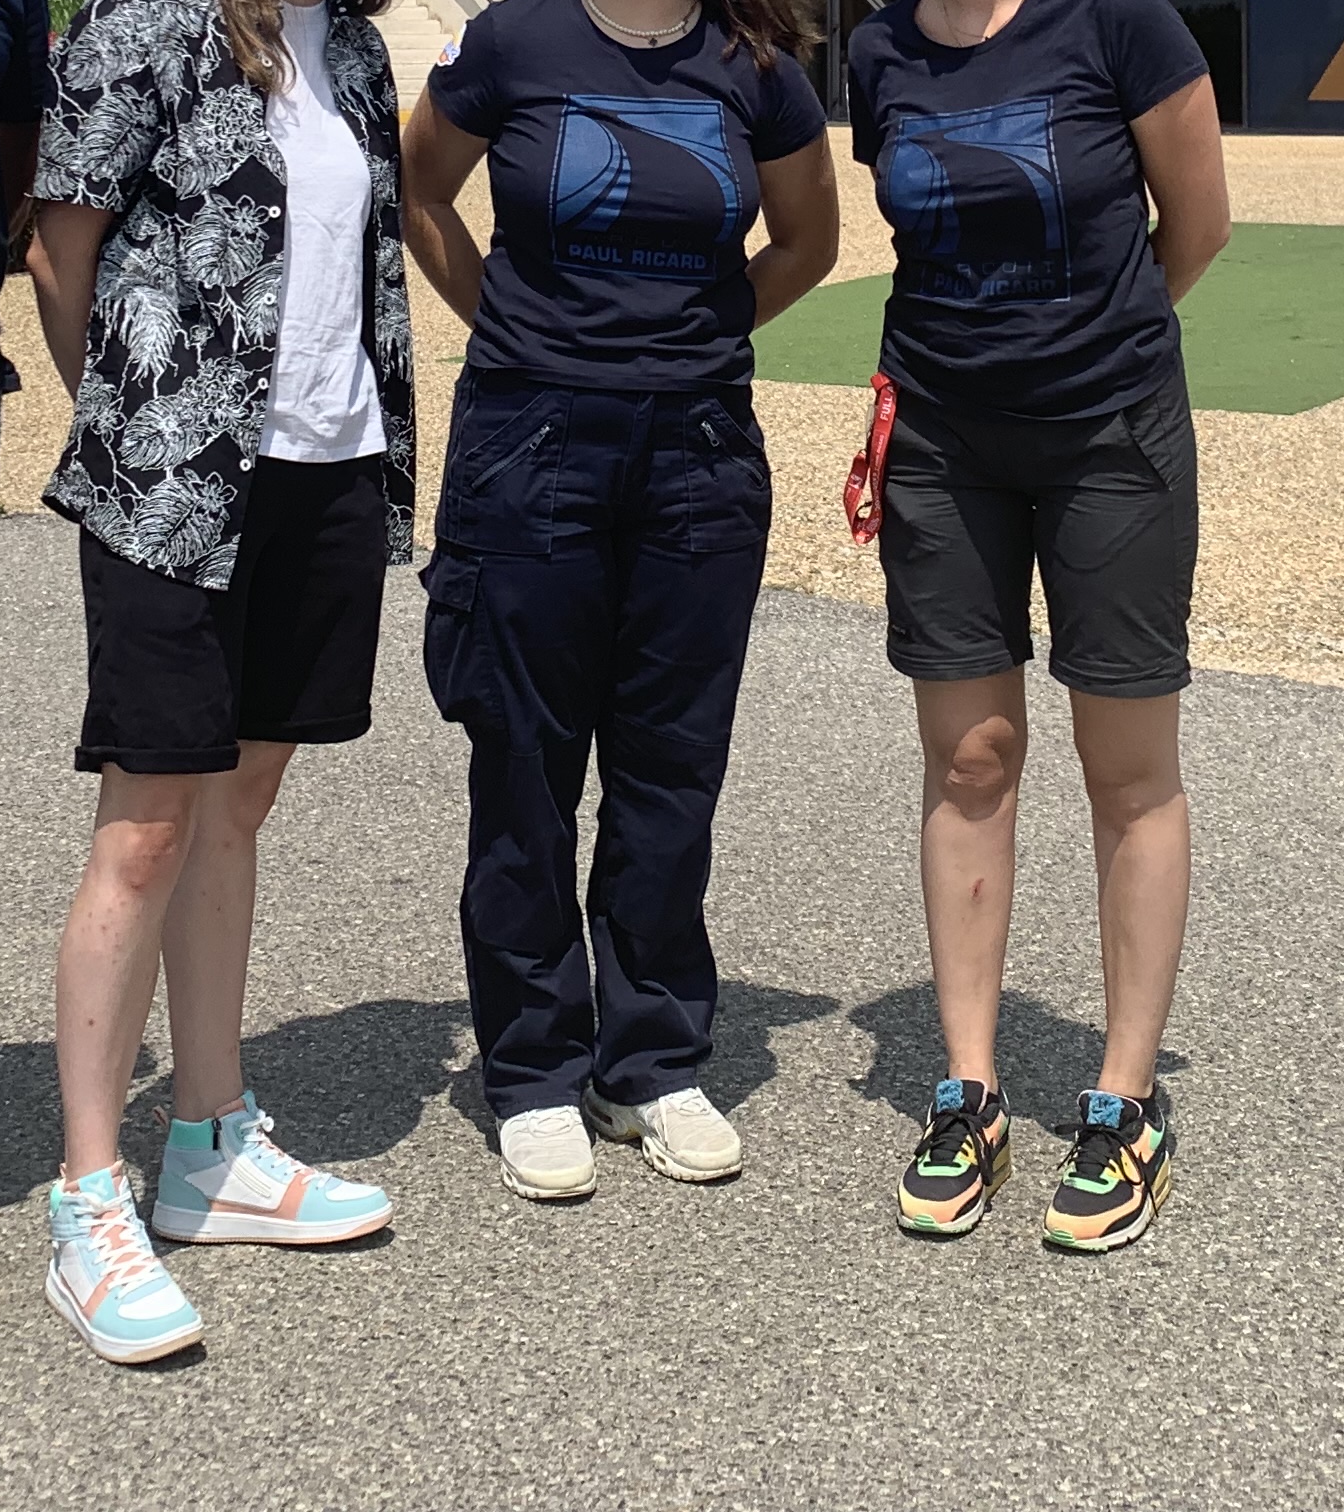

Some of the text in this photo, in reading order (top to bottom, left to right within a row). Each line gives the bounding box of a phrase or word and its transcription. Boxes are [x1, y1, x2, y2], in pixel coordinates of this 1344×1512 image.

[568, 244, 706, 269] PAUL RICARD
[880, 396, 893, 422] FULL
